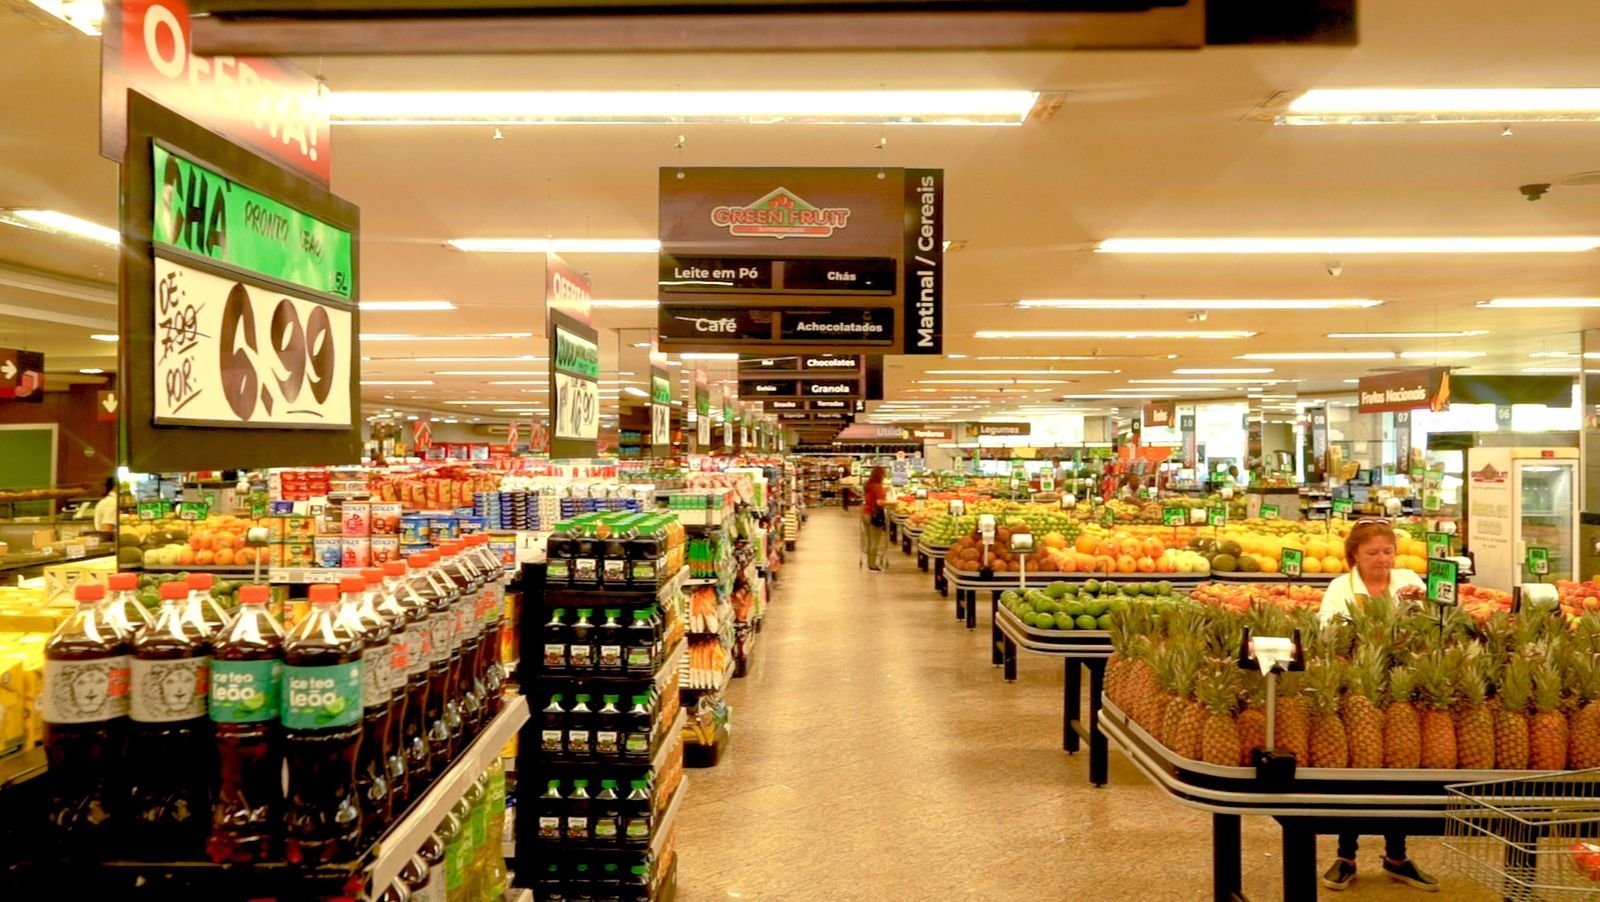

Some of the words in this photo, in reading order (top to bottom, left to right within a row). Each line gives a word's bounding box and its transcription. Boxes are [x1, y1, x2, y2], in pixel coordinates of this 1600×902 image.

[715, 209, 783, 225] GREEN
[789, 208, 847, 226] FRUIT
[916, 175, 935, 252] Cereais
[674, 266, 709, 280] Leite
[711, 269, 736, 280] em
[738, 266, 758, 280] Pó
[826, 270, 857, 282] Chás
[916, 270, 935, 348] Matinal
[695, 317, 737, 333] Café
[796, 321, 883, 334] Achocolatados
[806, 358, 855, 368] Chocolates
[811, 383, 850, 394] Granola
[1361, 390, 1385, 404] Frutas
[1386, 385, 1426, 402] Nacionais
[1183, 419, 1194, 428] 10
[1398, 413, 1409, 423] 07
[980, 425, 1020, 435] Legumes
[213, 672, 228, 684] ice
[229, 672, 254, 684] tea
[289, 678, 308, 690] ice
[309, 678, 335, 690] tea
[213, 683, 256, 702] leão
[289, 689, 337, 707] leão
